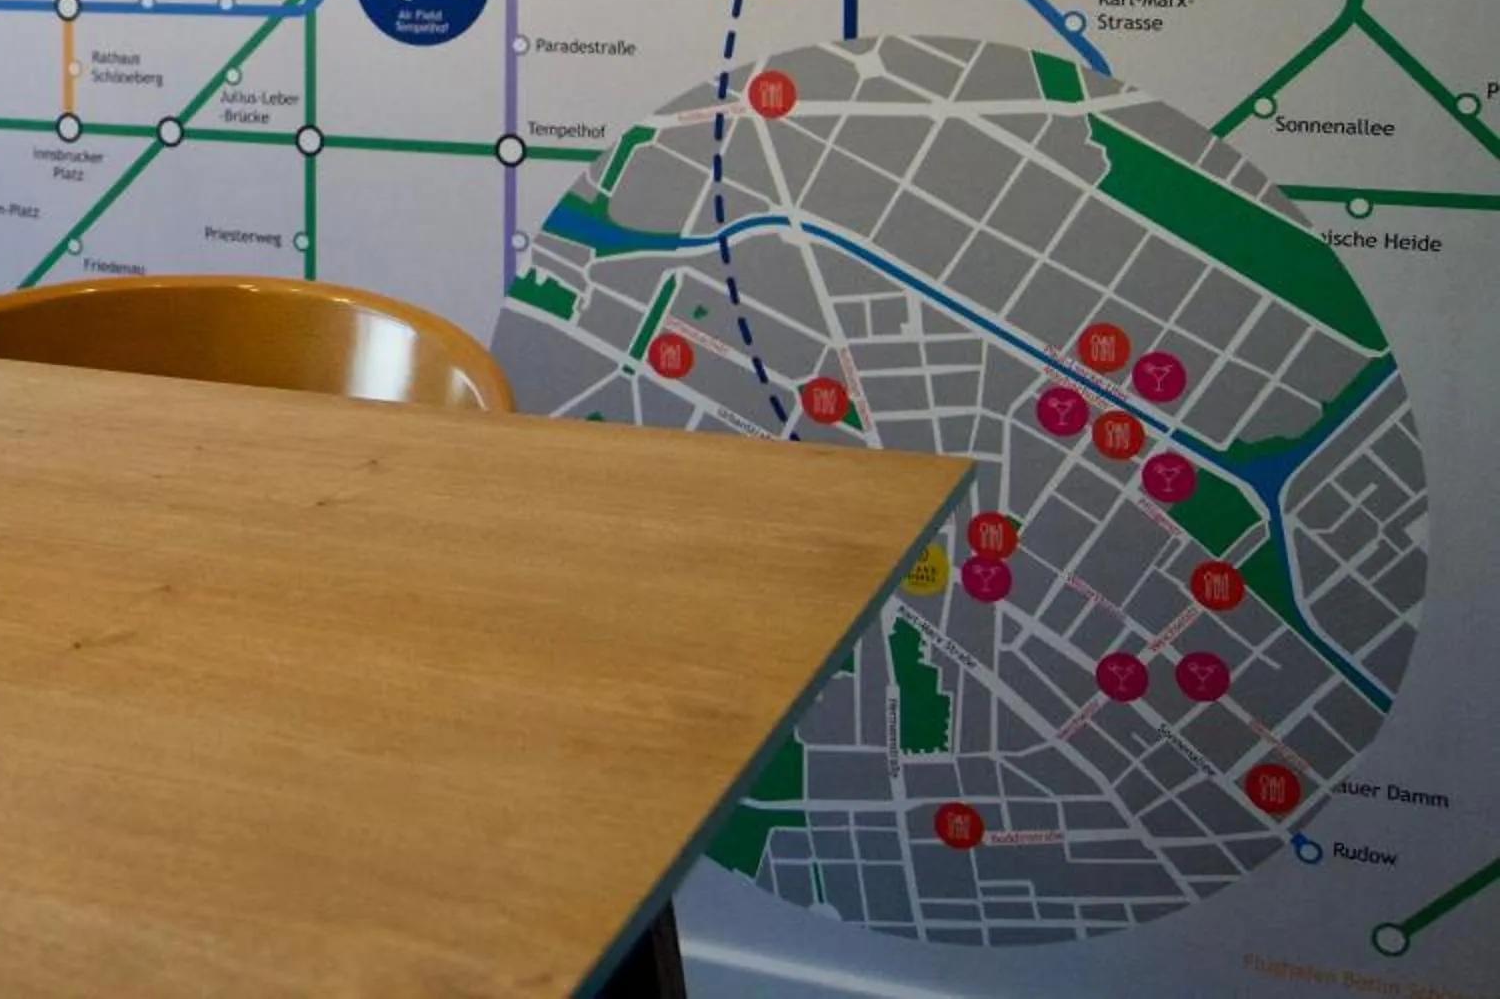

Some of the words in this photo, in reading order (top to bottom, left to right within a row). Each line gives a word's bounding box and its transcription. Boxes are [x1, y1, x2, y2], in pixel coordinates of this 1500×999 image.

[1097, 14, 1163, 32] Strasse
[536, 38, 636, 57] Paradestraße
[528, 121, 608, 139] Tempelhof
[1275, 116, 1395, 137] Sonnenallee
[204, 226, 282, 248] Priesterweg
[1384, 232, 1442, 252] Heide
[1388, 783, 1449, 808] Damm
[1333, 842, 1396, 866] Rudow
